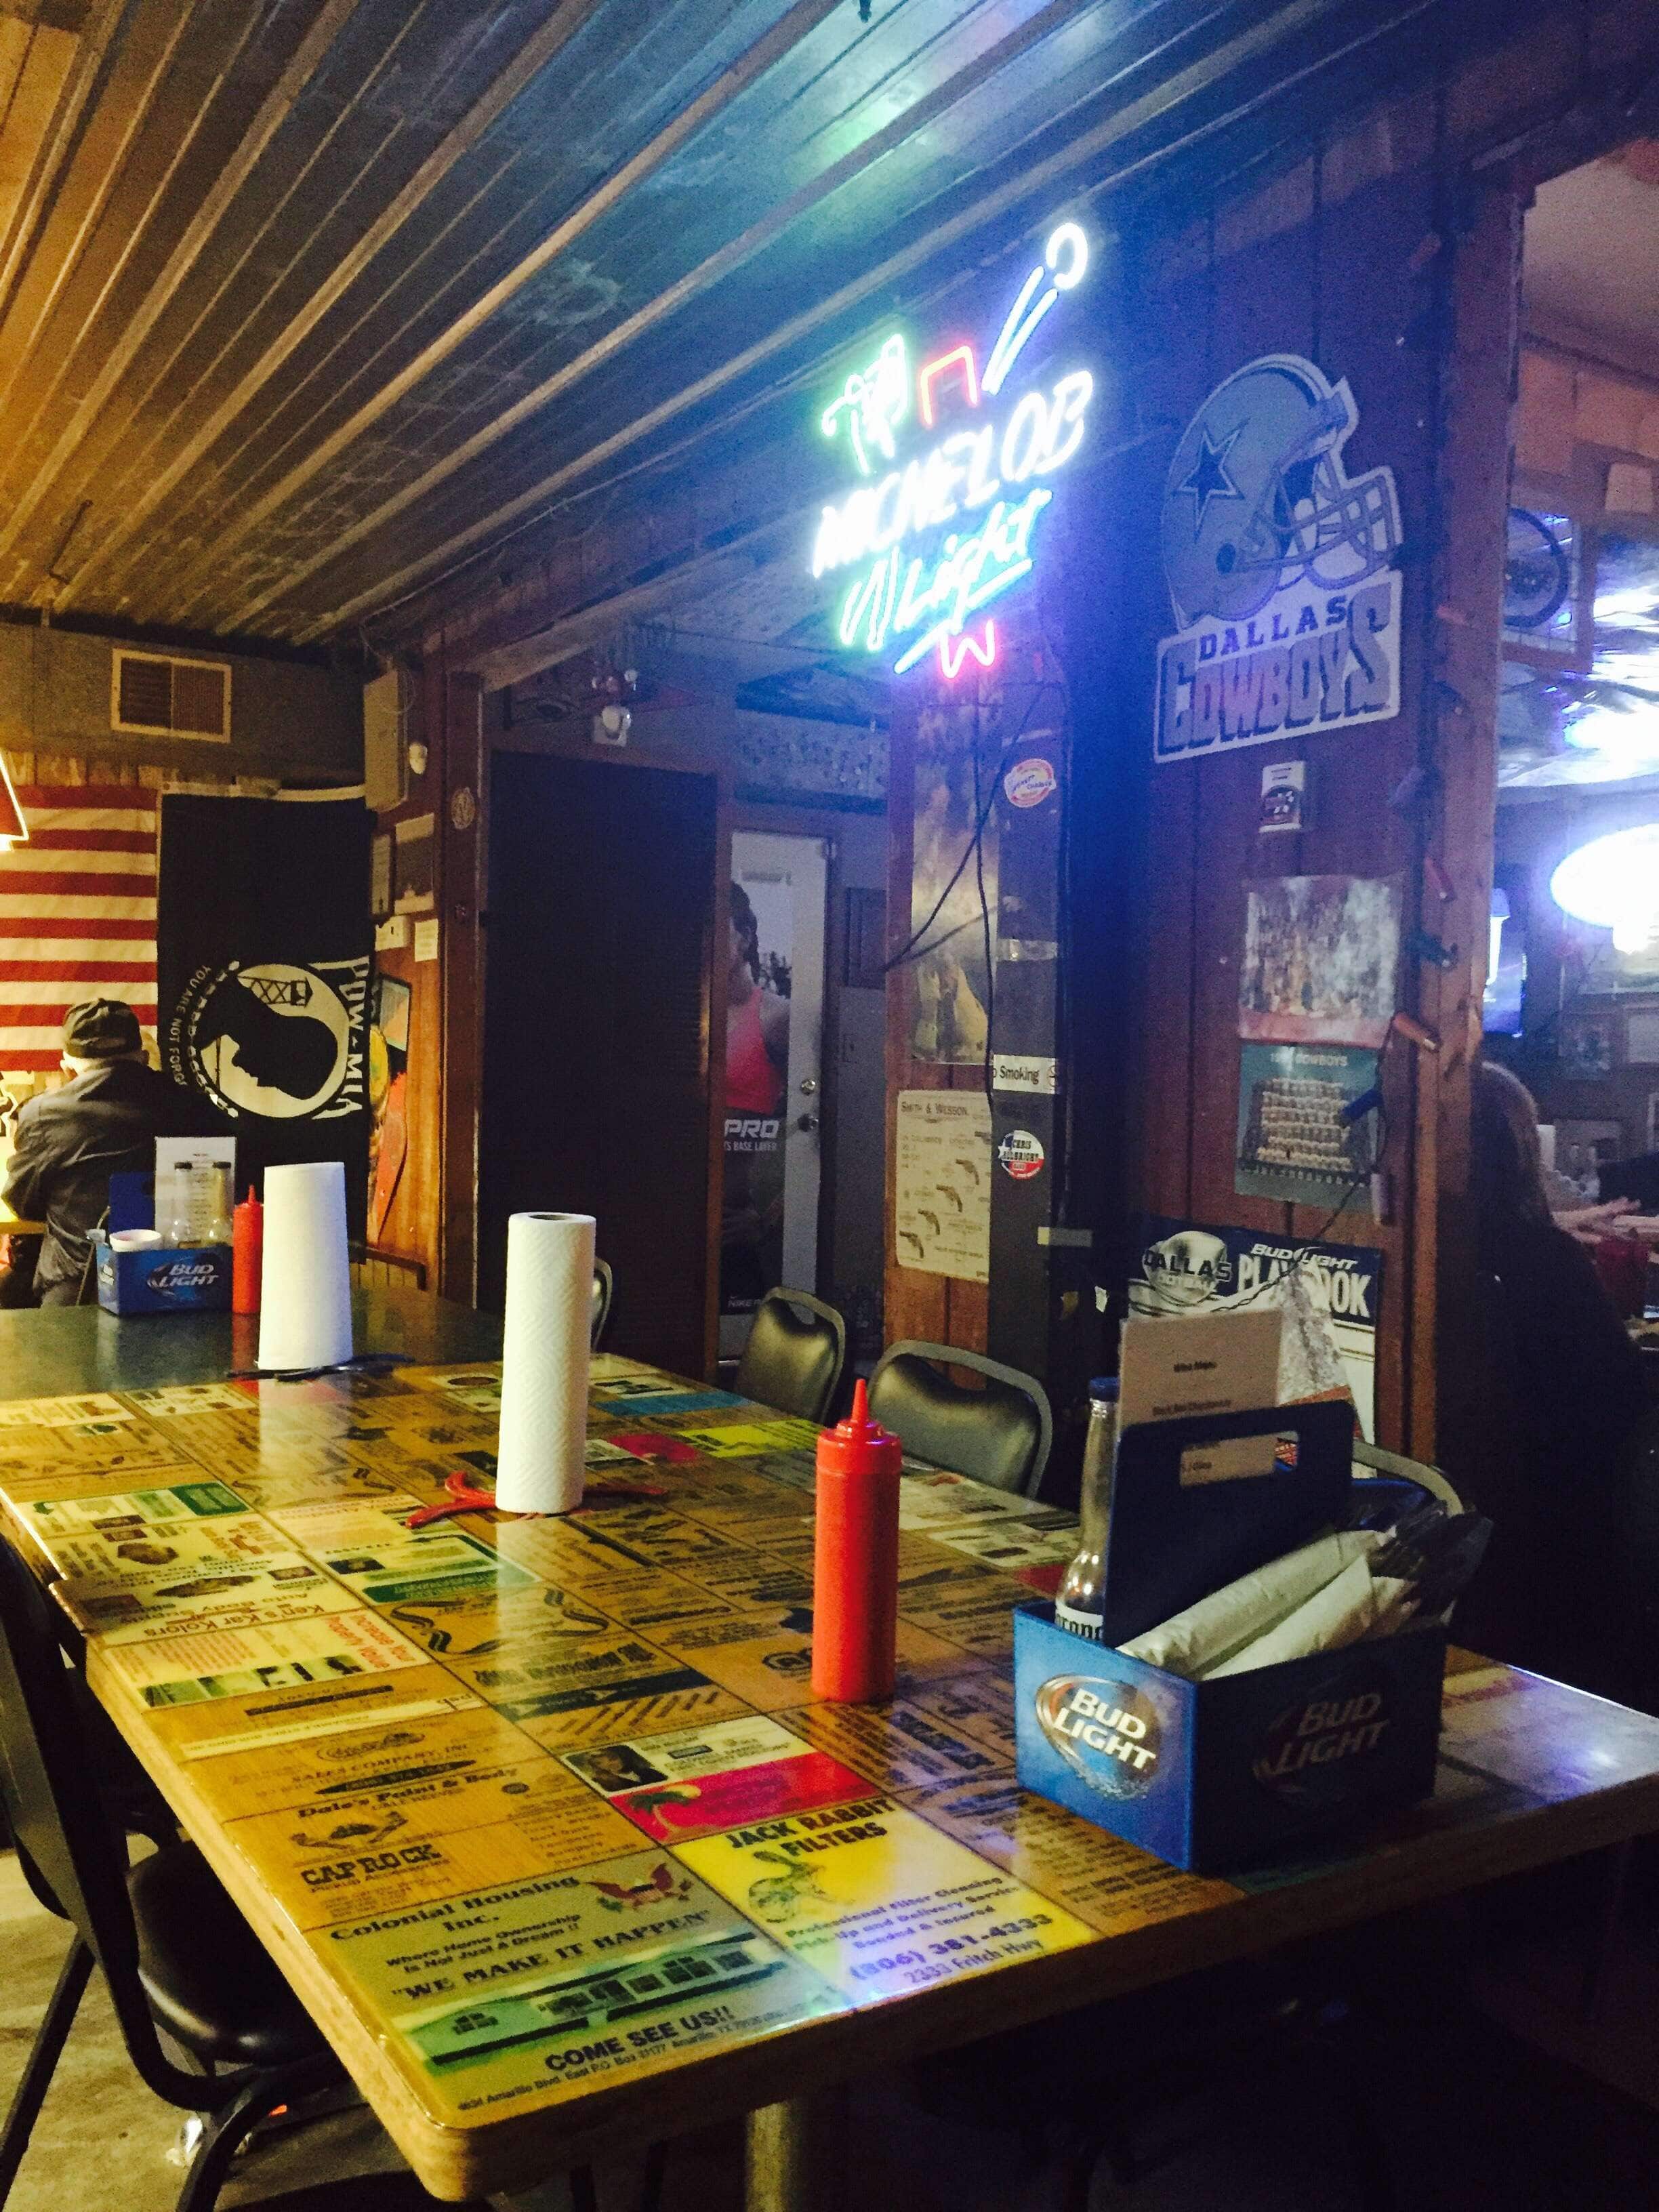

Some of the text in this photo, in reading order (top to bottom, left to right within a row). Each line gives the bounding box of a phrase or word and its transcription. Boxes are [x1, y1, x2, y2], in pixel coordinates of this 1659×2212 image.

[812, 370, 1094, 578] MICHELOB
[1199, 595, 1348, 661] DALLAS
[1159, 581, 1393, 754] COWBOYS
[189, 965, 211, 989] YOU
[176, 987, 193, 1014] ARE
[169, 1018, 182, 1042] NOT
[311, 1052, 363, 1120] MIA
[1000, 1065, 1040, 1085] Smoking
[724, 1118, 780, 1139] PRO
[926, 1103, 933, 1115] &
[935, 1103, 968, 1116] WESSON
[733, 1141, 753, 1151] BASE
[169, 1264, 214, 1275] BUD
[1144, 1250, 1233, 1283] DALLAS
[1250, 1243, 1358, 1271] BUD LIGHT
[159, 1274, 219, 1288] LIGHT
[144, 1603, 325, 1637] Ken's Kar Kolors
[1070, 1687, 1147, 1739] BUD
[1296, 1694, 1382, 1737] BUD
[1051, 1714, 1156, 1770] LIGHT
[1274, 1719, 1389, 1773] LIGHT
[298, 1798, 369, 1819] Dale's
[376, 1784, 436, 1803] Paint
[443, 1778, 458, 1788] &
[465, 1767, 518, 1784] Body
[725, 1798, 895, 1849] JACK RABBIT
[779, 1822, 888, 1857] FILTERS
[331, 1903, 455, 1940] Colonial
[463, 1876, 581, 1910] Housing
[862, 1918, 895, 1933] and
[896, 1900, 964, 1923] Delivery
[965, 1885, 1021, 1903] Service
[889, 1896, 932, 1910] Filter
[935, 1877, 1004, 1898] Cleaning
[386, 1913, 581, 1967] Where Home Ownership
[443, 1914, 500, 1932] Inc.
[851, 1904, 997, 1950] Bonded & Insured
[928, 1913, 1053, 1956] 381-4333
[391, 1908, 710, 2000] "WE MAKE IT HAPPEN"
[403, 1964, 422, 1973] Is
[424, 1956, 453, 1969] Not
[458, 1945, 493, 1960] Just
[497, 1941, 509, 1950] A
[512, 1928, 565, 1946] Dream
[951, 1947, 1004, 1971] Fritch
[1002, 1938, 1045, 1956] Hwy
[544, 2036, 626, 2072] COME
[626, 2020, 679, 2049] SEE
[681, 2005, 737, 2033] US!!
[487, 2083, 533, 2103] Amarillo
[566, 2066, 590, 2079] East
[613, 2051, 638, 2064] Box
